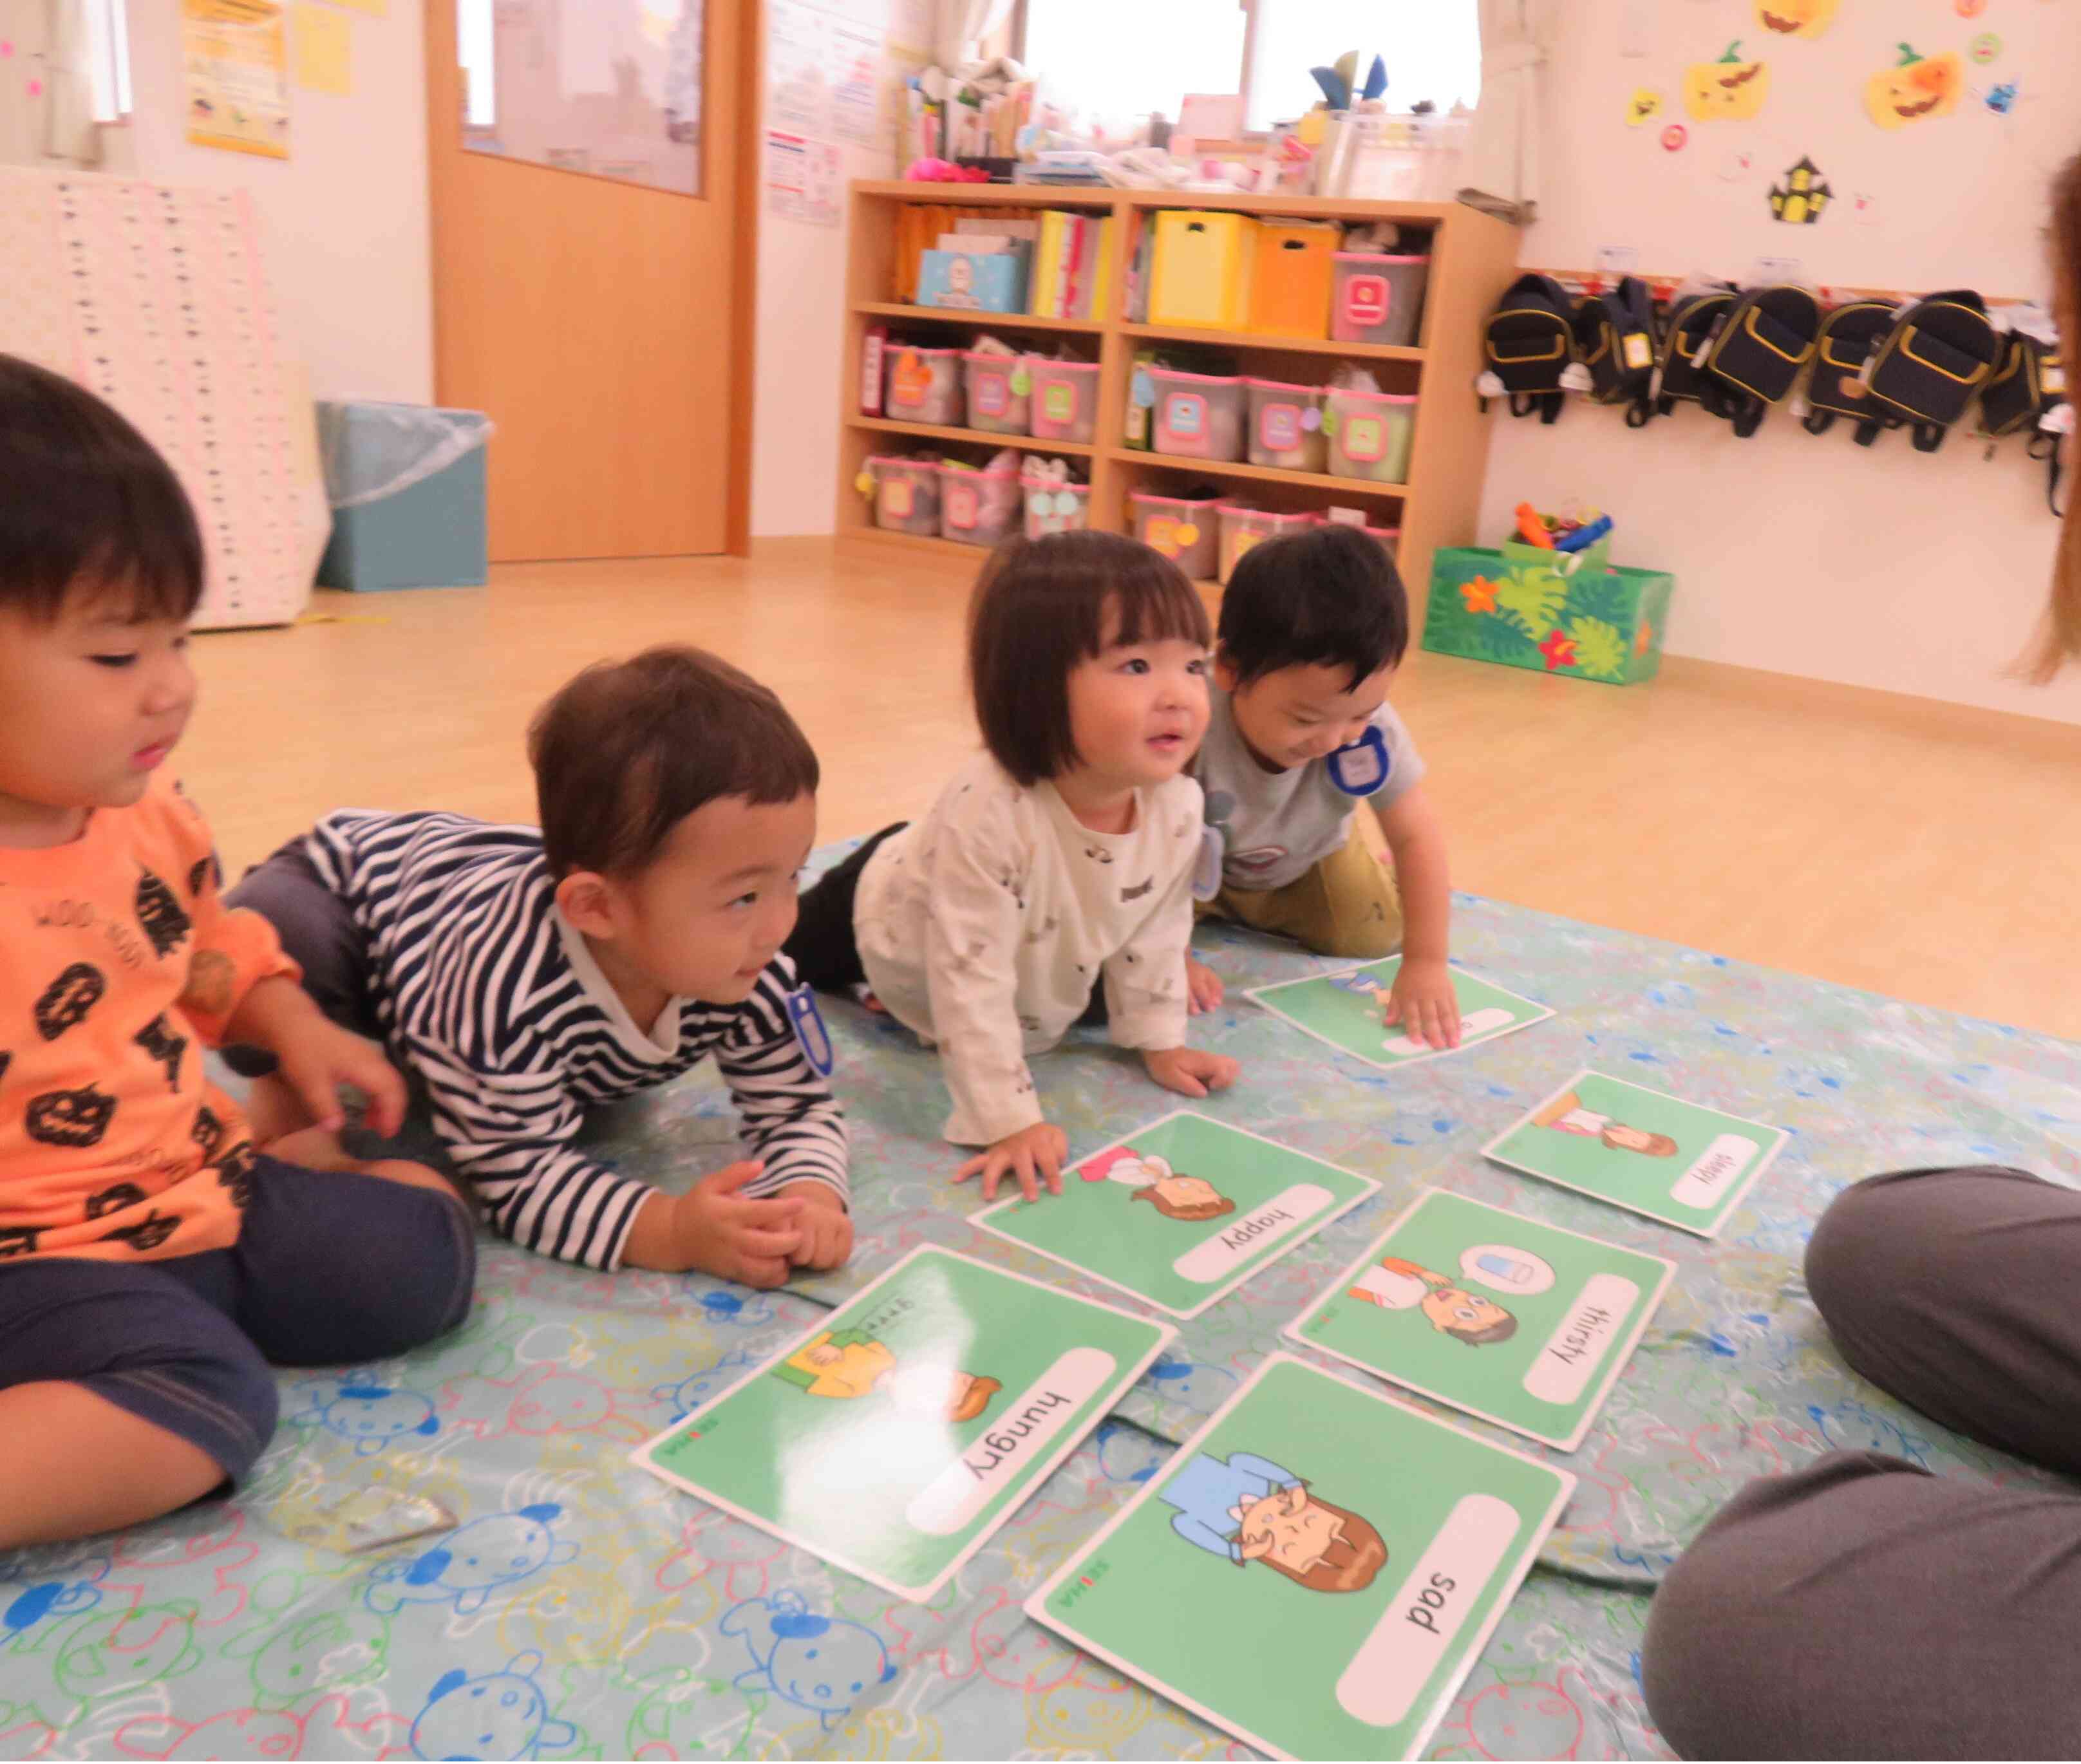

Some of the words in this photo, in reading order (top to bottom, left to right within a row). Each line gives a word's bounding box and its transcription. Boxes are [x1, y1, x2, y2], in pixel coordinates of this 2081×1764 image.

[1220, 1208, 1295, 1250] happy
[1547, 1306, 1612, 1365] thirsty
[963, 1391, 1071, 1479] hungry
[1406, 1572, 1456, 1633] sad
